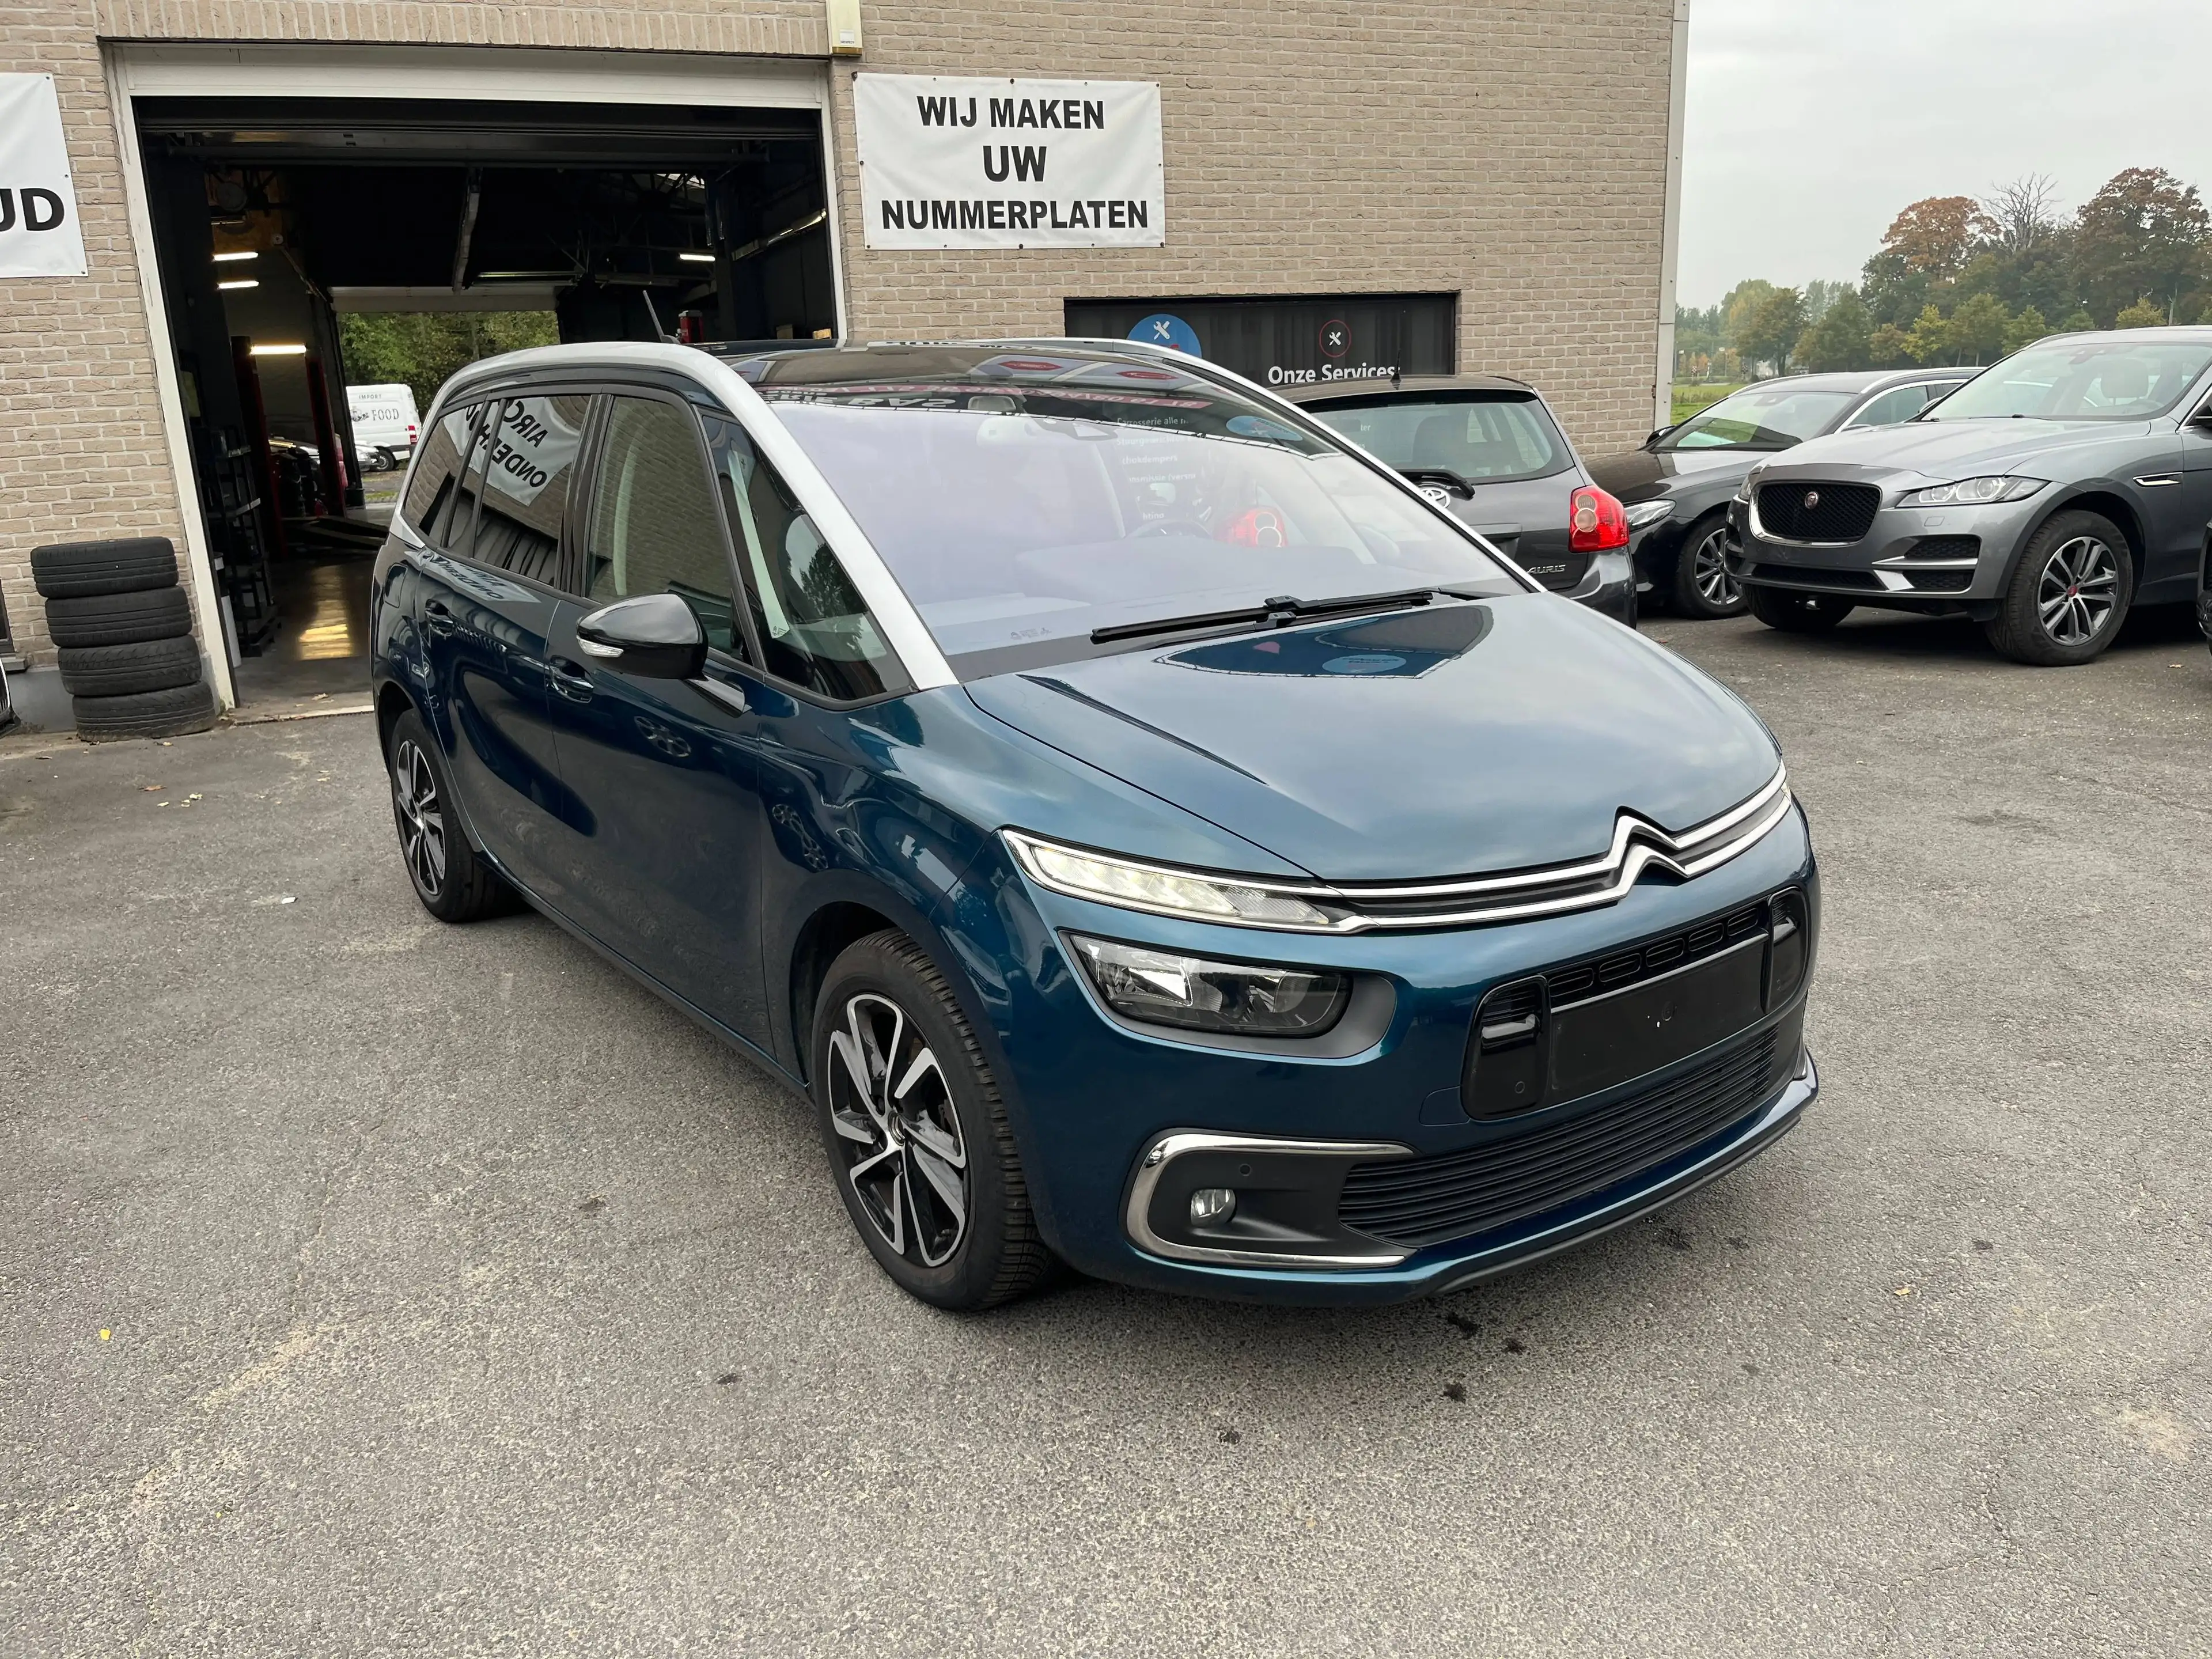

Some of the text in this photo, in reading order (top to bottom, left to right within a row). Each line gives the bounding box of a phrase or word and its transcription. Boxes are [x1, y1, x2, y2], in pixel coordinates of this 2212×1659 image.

[916, 96, 1105, 129] WIJ MAKEN
[983, 145, 1047, 182] UW
[881, 200, 1147, 230] NUMMERPLATEN
[1268, 365, 1316, 385] Onze
[372, 408, 399, 421] FOOD
[1164, 416, 1178, 425] alle
[1527, 564, 1566, 575] AURIS
